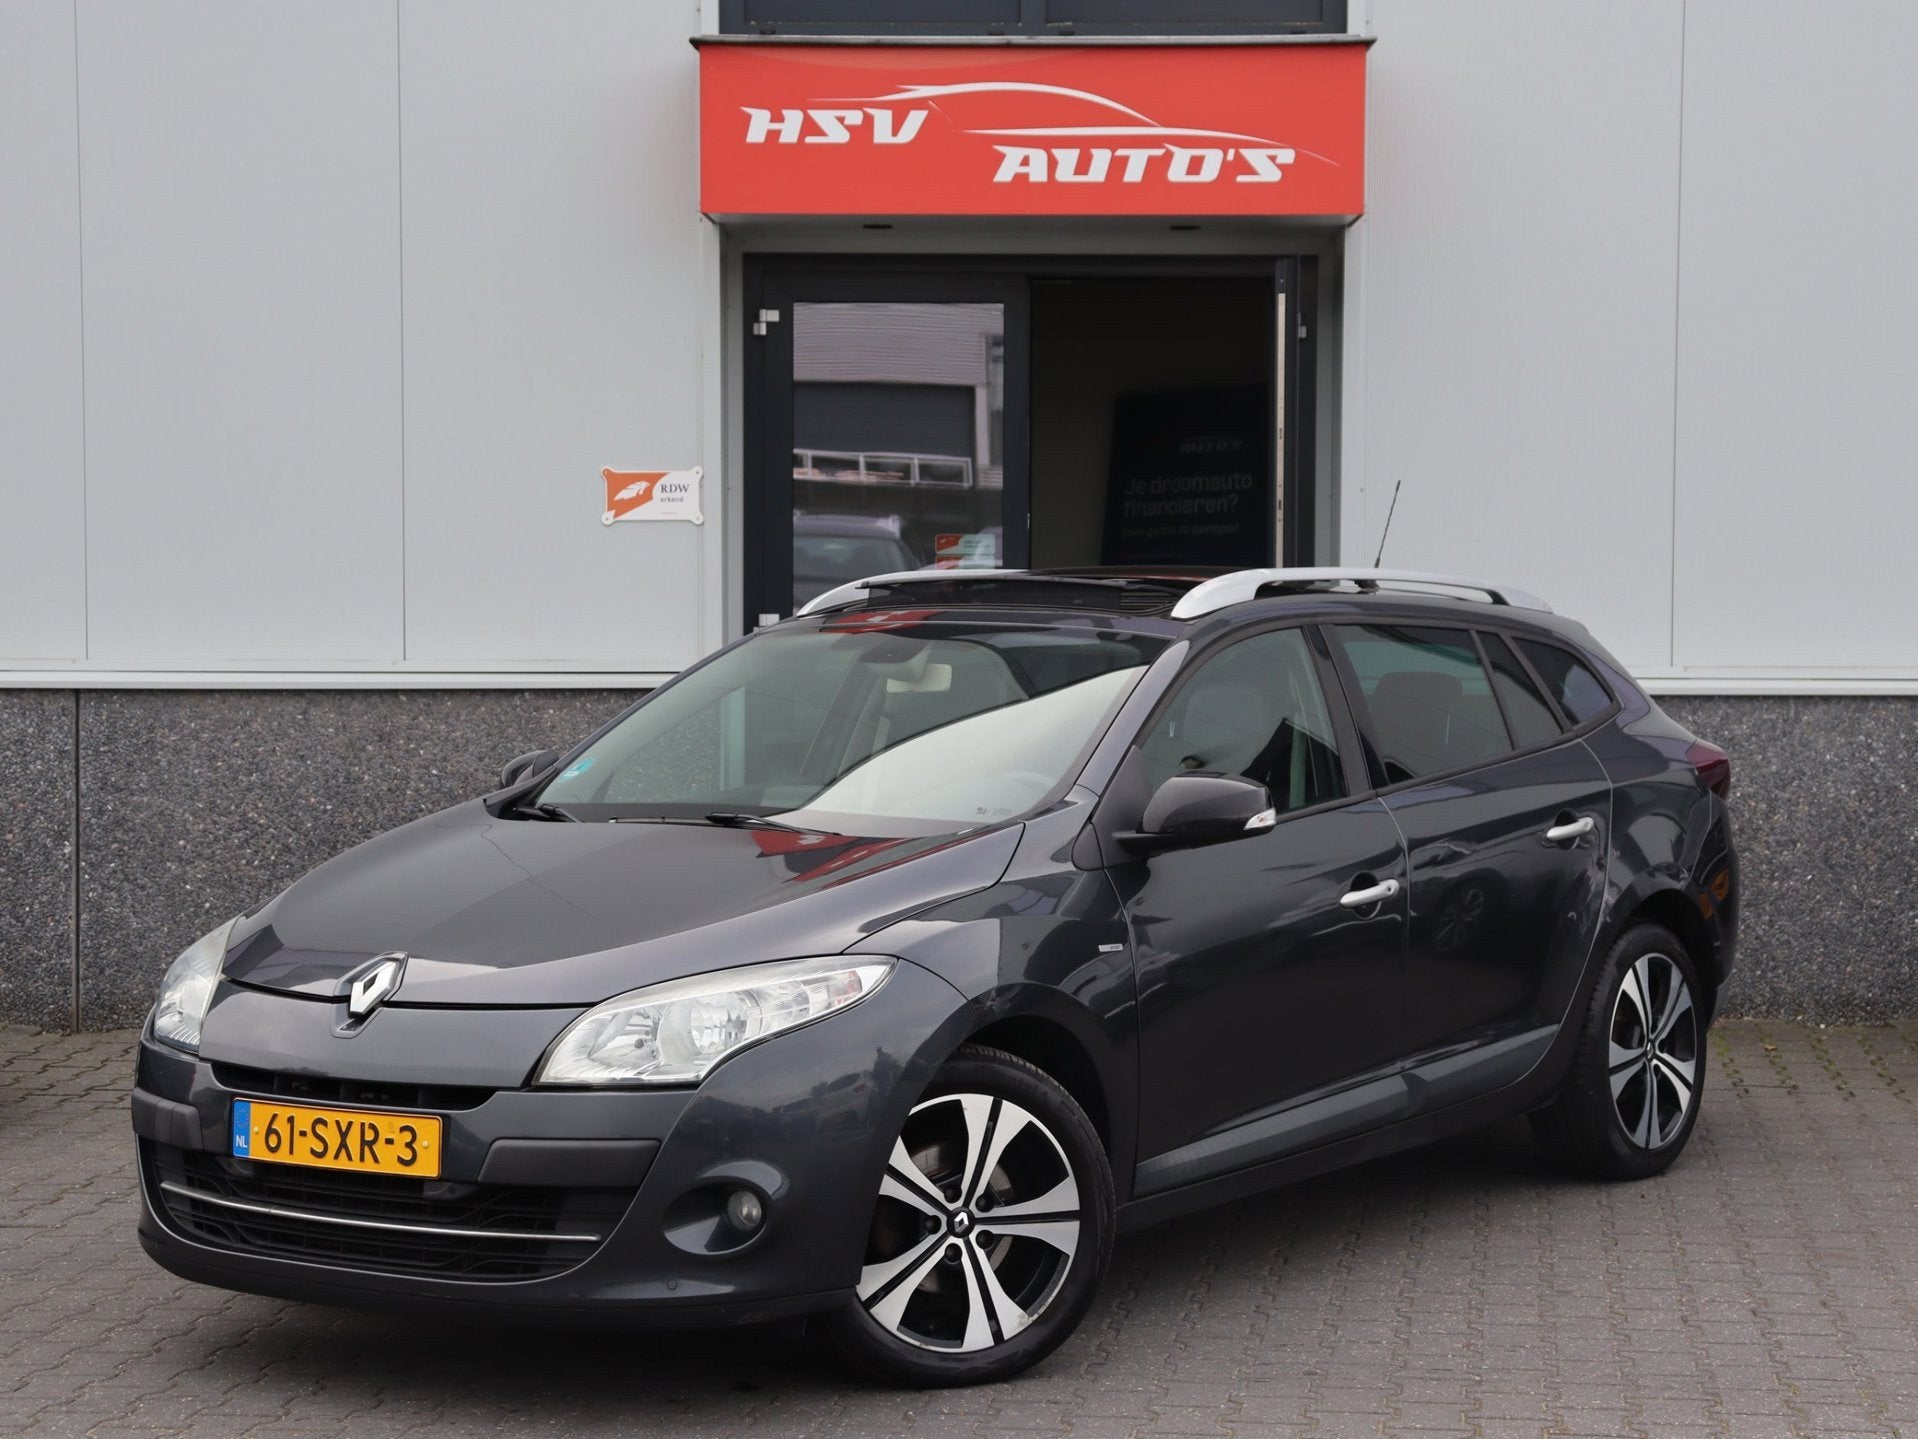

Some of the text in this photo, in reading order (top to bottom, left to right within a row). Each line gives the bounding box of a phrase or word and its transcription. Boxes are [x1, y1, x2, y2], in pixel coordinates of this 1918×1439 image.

[740, 106, 928, 144] HSV
[992, 144, 1296, 184] AUTO'S
[661, 483, 690, 494] RDW
[1124, 472, 1253, 496] Je droomauto
[1123, 493, 1239, 518] financieren?
[235, 1134, 247, 1148] NL
[264, 1112, 418, 1167] 61-SXR-3
